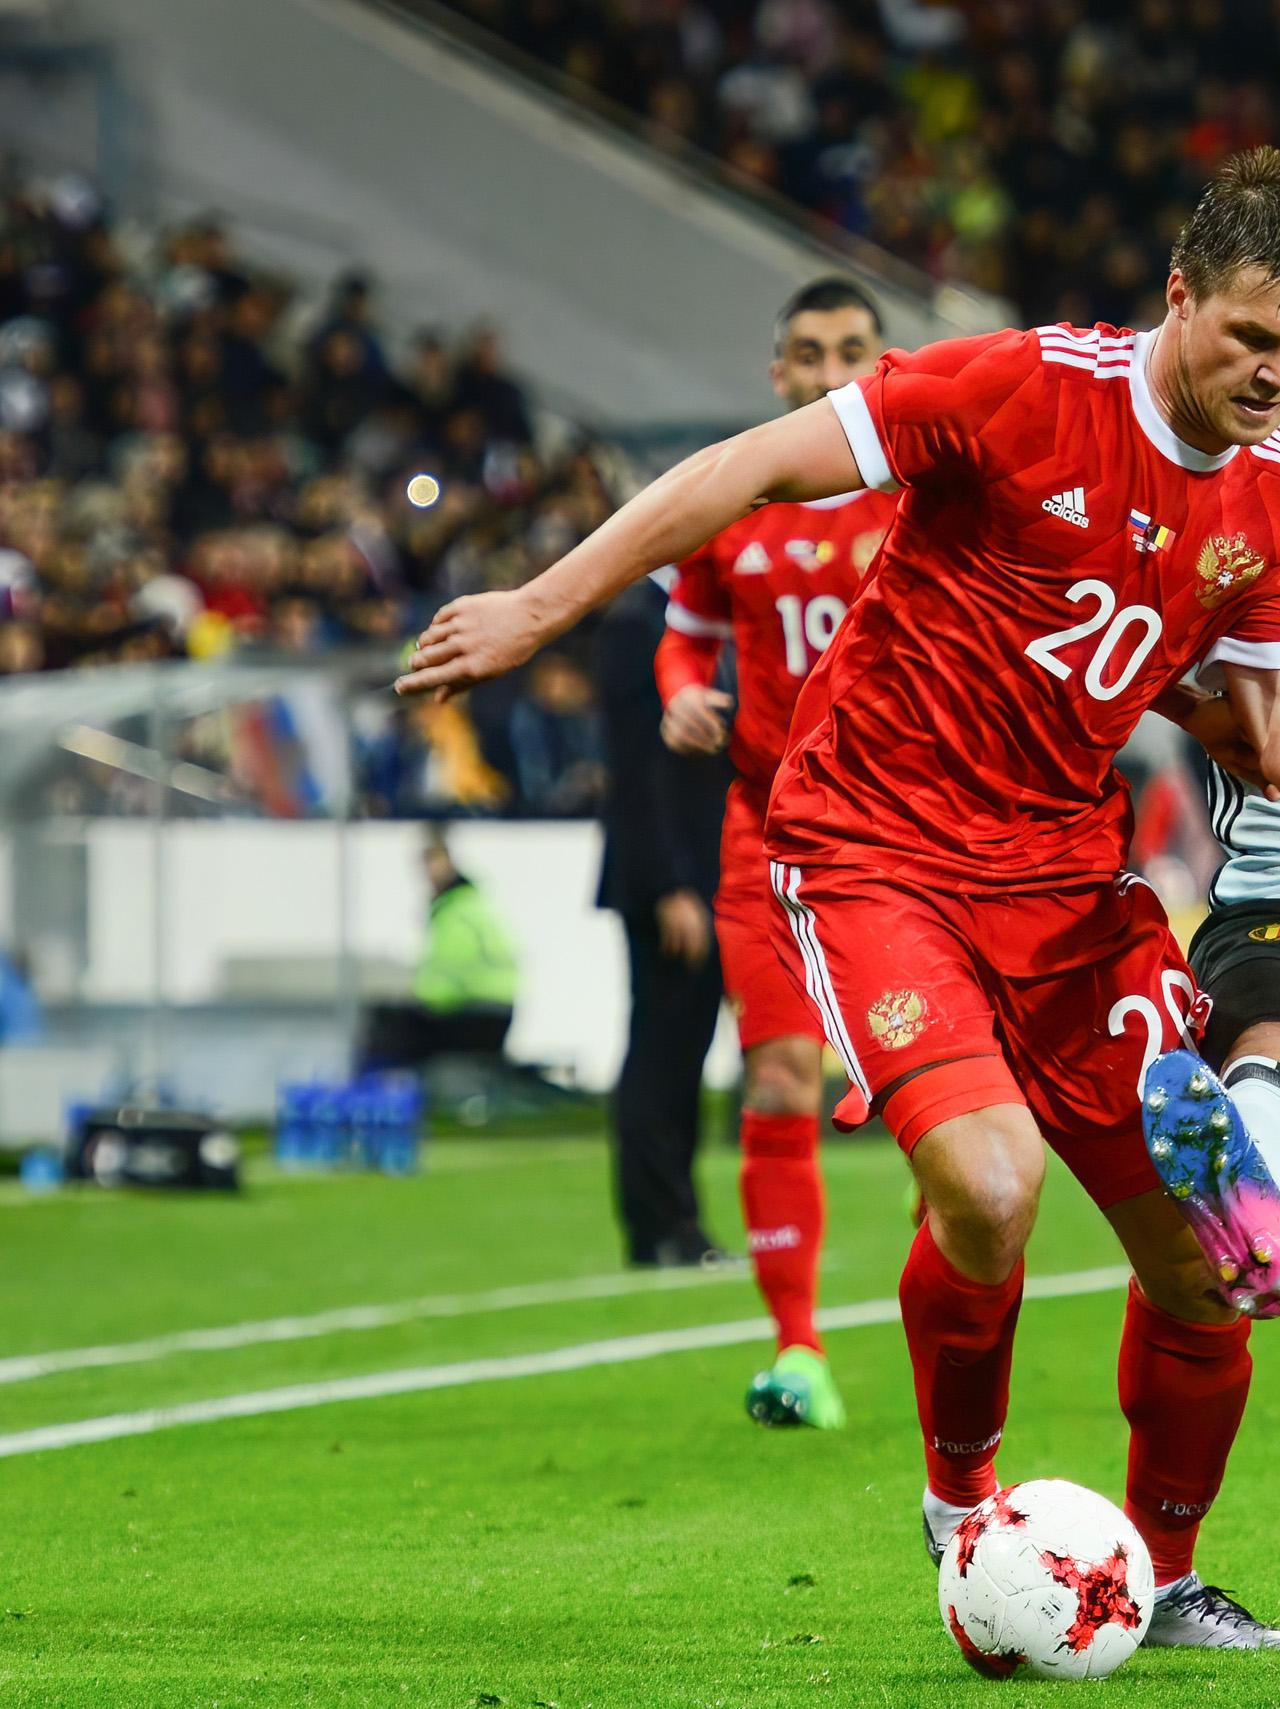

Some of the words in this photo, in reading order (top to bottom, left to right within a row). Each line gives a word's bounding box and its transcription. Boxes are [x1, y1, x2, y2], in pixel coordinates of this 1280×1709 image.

[1041, 499, 1090, 529] adidas
[1024, 579, 1163, 701] 20
[1108, 969, 1213, 1103] 20
